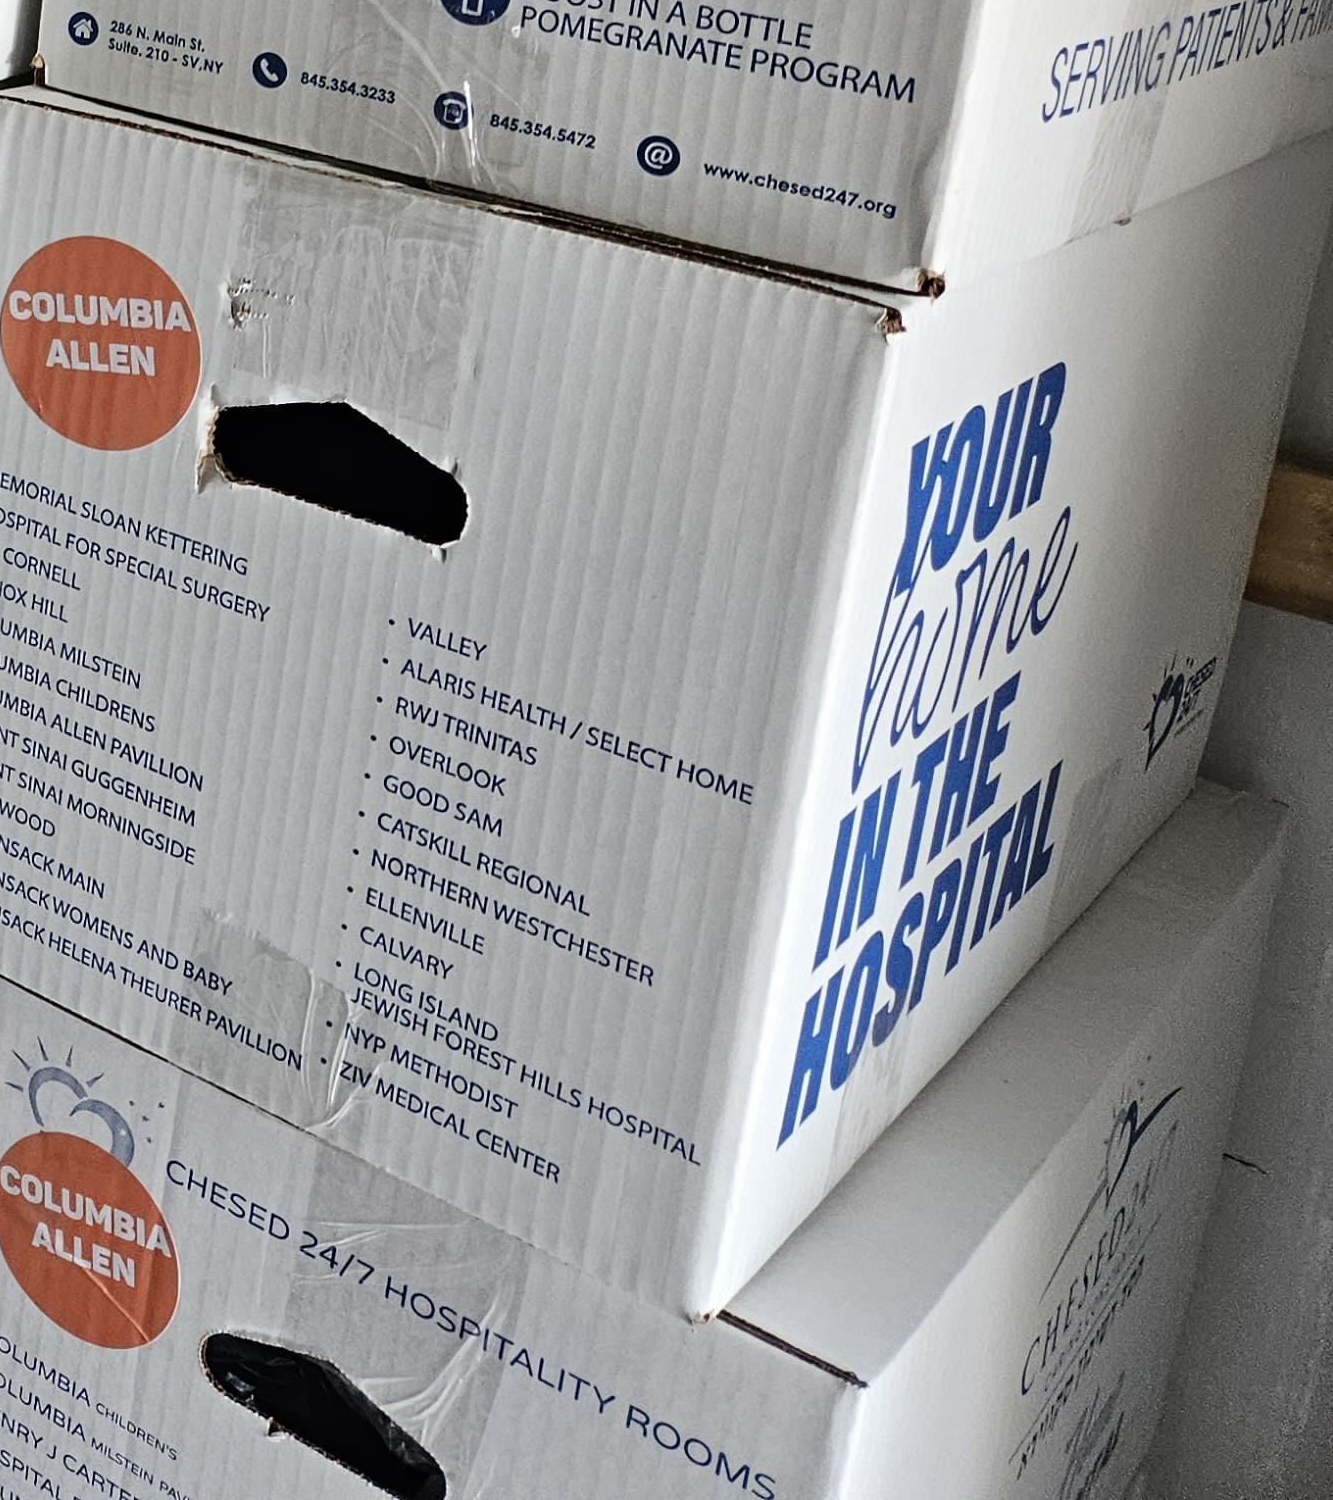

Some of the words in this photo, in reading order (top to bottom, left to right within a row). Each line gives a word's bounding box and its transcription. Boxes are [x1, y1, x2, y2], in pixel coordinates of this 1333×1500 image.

[110, 21, 132, 35] 286
[137, 27, 149, 40] N.
[153, 30, 185, 47] Main
[190, 38, 204, 52] St.
[146, 47, 169, 62] 210
[521, 6, 743, 69] POMEGRANATE
[751, 49, 915, 102] PROGRAM
[666, 1, 686, 26] A
[696, 5, 813, 48] BOTTLE
[301, 72, 395, 103] 845.354.3233
[1042, 21, 1171, 123] SERVING
[490, 114, 595, 148] 845.354.5472
[704, 164, 896, 219] www.chesed247.org
[9, 291, 194, 332] COLUMBIA
[46, 339, 155, 376] ALLEN
[894, 361, 1067, 598] YOUR
[409, 618, 487, 660] VALLEY
[851, 505, 1078, 794] home
[401, 660, 475, 699] ALARIS
[481, 687, 566, 734] HEALTH
[570, 722, 582, 739] /
[586, 727, 672, 772] SELECT
[677, 760, 753, 805] HOME
[812, 770, 901, 973] IN
[899, 671, 1021, 890] THE
[776, 760, 1063, 1152] HOSPITAL
[1, 1166, 175, 1257] COLUMBIA
[32, 1222, 134, 1287] ALLEN
[167, 1161, 289, 1239] CHESED
[300, 1231, 374, 1284] 24/7
[385, 1276, 615, 1410] HOSPITALITY
[626, 1405, 775, 1500] ROOMS
[96, 1403, 177, 1460] CHILDREN'S
